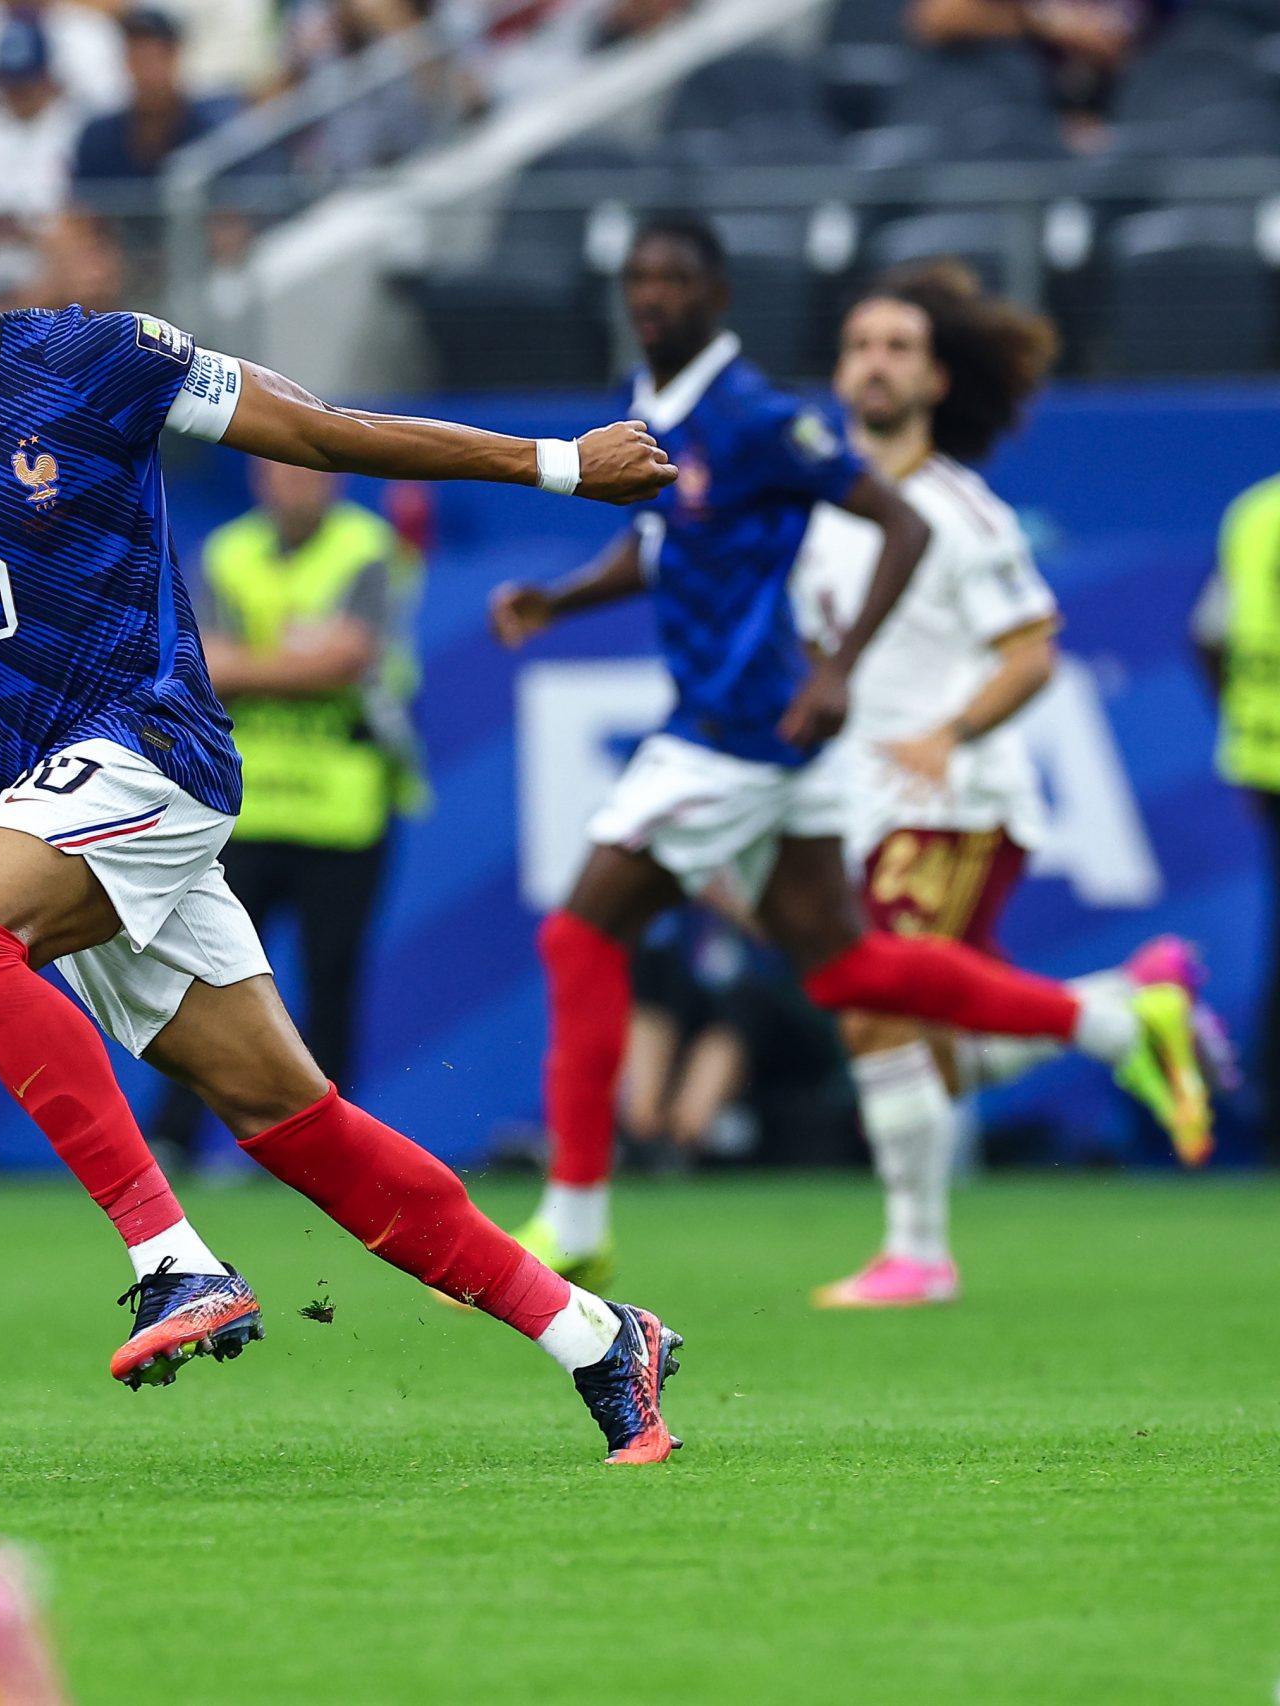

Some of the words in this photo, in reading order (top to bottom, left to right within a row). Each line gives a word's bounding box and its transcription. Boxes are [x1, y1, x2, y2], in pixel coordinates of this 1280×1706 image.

[192, 354, 212, 398] UNITES
[208, 386, 222, 405] the
[35, 500, 57, 512] FFF
[517, 658, 1160, 908] FA
